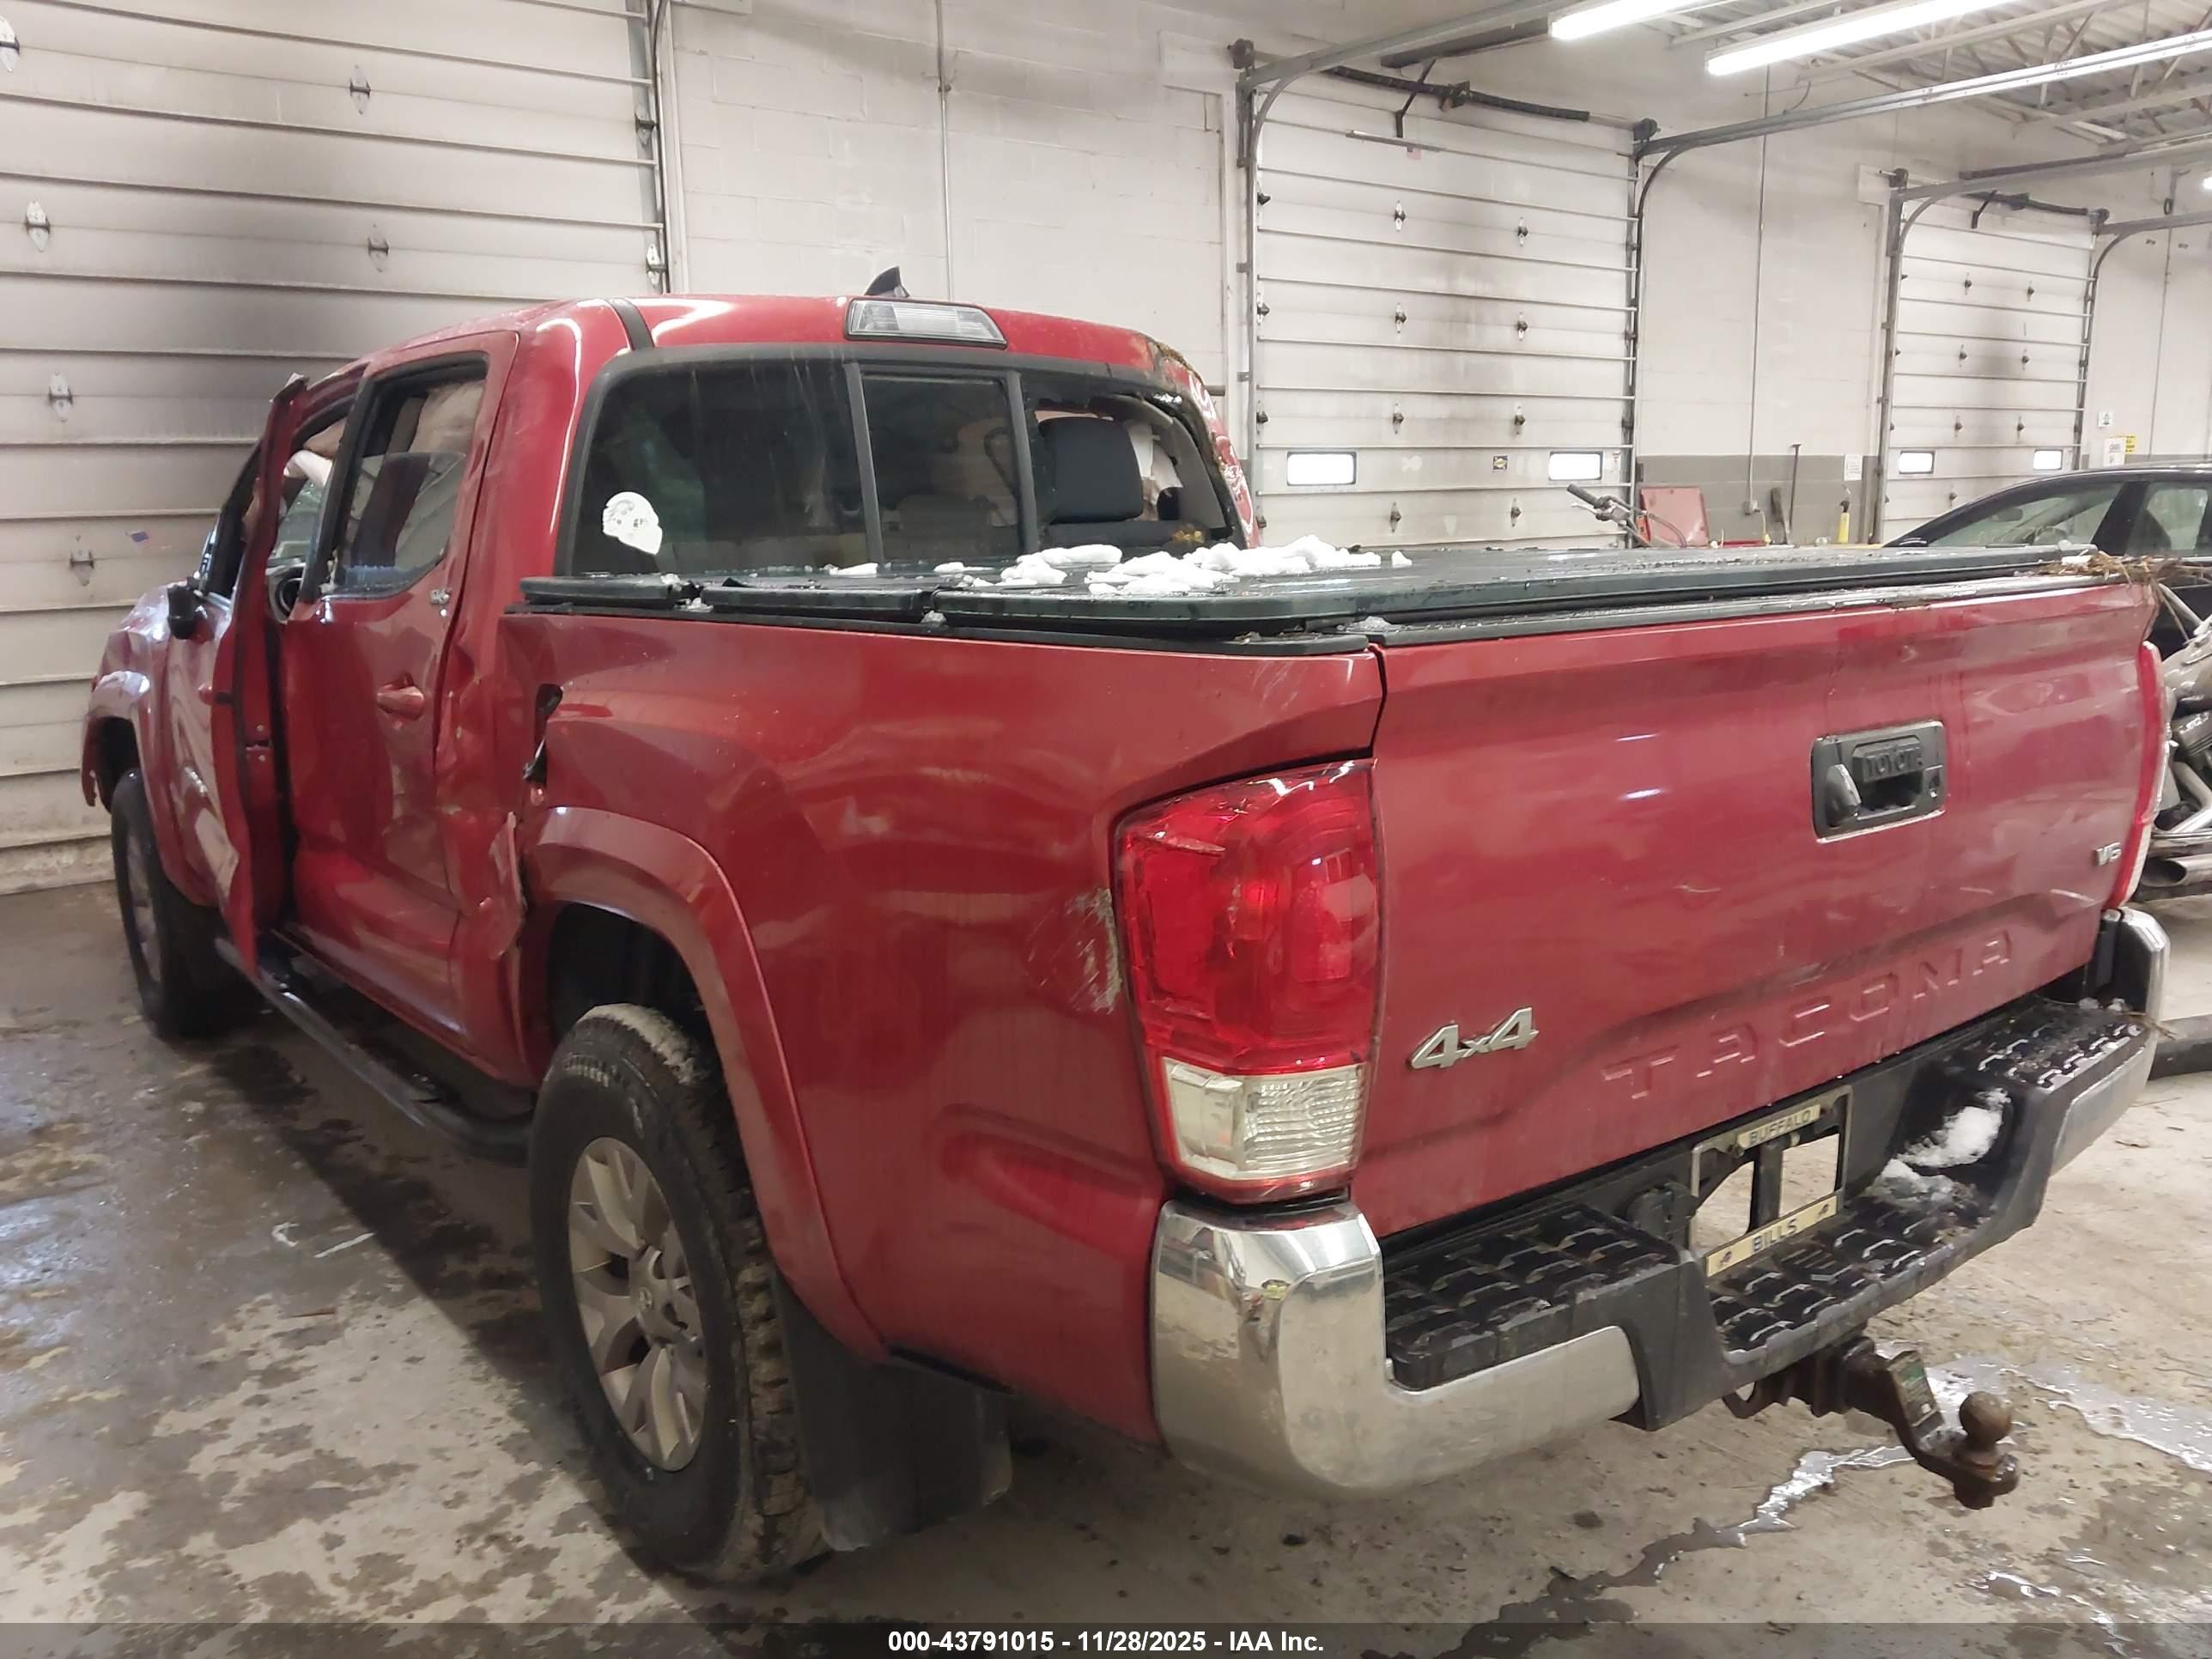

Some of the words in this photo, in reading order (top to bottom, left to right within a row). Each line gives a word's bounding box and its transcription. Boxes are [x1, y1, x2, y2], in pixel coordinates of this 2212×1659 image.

[2095, 842, 2122, 866] V6
[1601, 929, 2012, 1100] TACOMA
[1749, 1109, 1812, 1145] BUFFALO
[1752, 1218, 1798, 1252] BILLS
